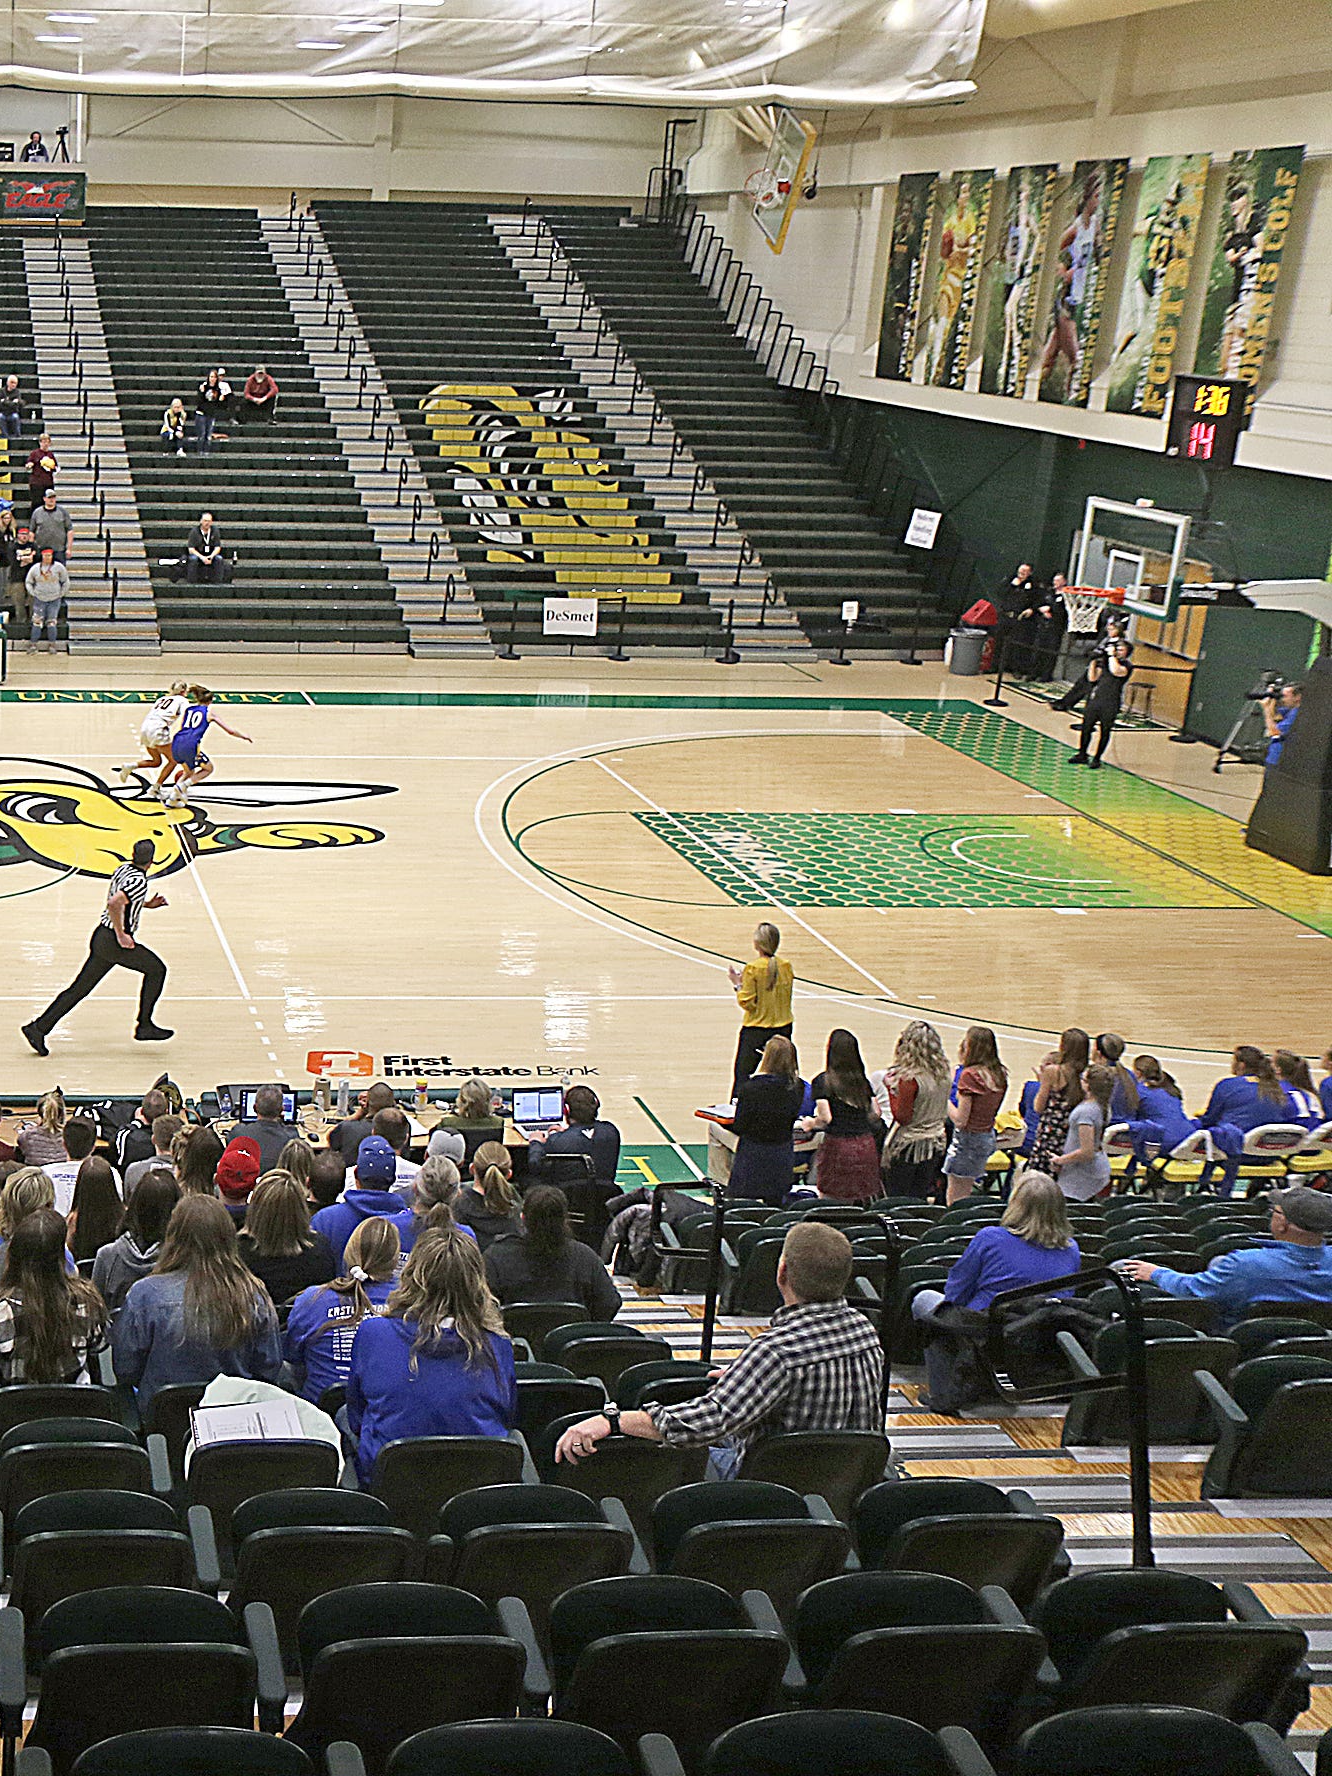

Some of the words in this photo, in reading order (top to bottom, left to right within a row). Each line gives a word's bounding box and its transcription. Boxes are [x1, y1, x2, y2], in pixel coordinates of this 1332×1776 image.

[4, 192, 71, 208] EAGLE
[546, 610, 594, 622] DeSmet
[184, 710, 203, 728] 10
[383, 1055, 452, 1066] First
[384, 1066, 531, 1077] Interstate
[536, 1065, 600, 1077] Bank
